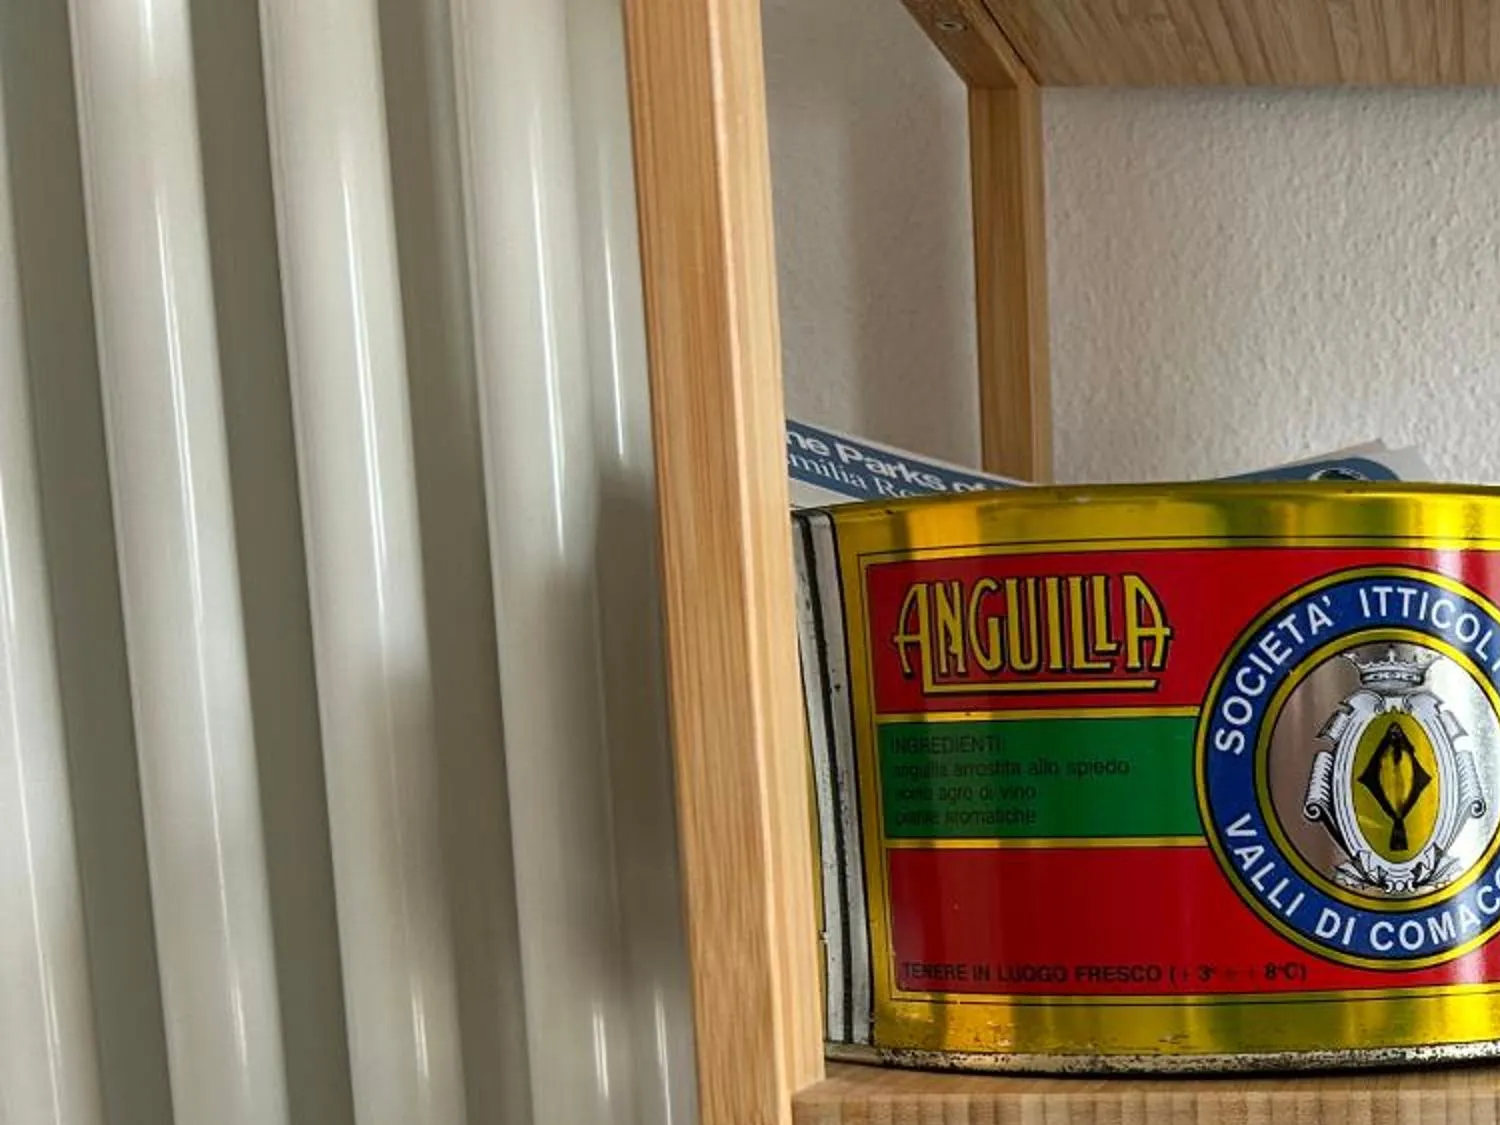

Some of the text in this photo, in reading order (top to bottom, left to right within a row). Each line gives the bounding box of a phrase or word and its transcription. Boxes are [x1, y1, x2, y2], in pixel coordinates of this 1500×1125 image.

[788, 450, 867, 489] milia
[893, 573, 1172, 693] ANGUILLA
[1215, 596, 1333, 755] SOCIETA'
[1225, 814, 1304, 917] VALLI
[1315, 908, 1356, 946] DI
[1074, 963, 1162, 983] FRESCO
